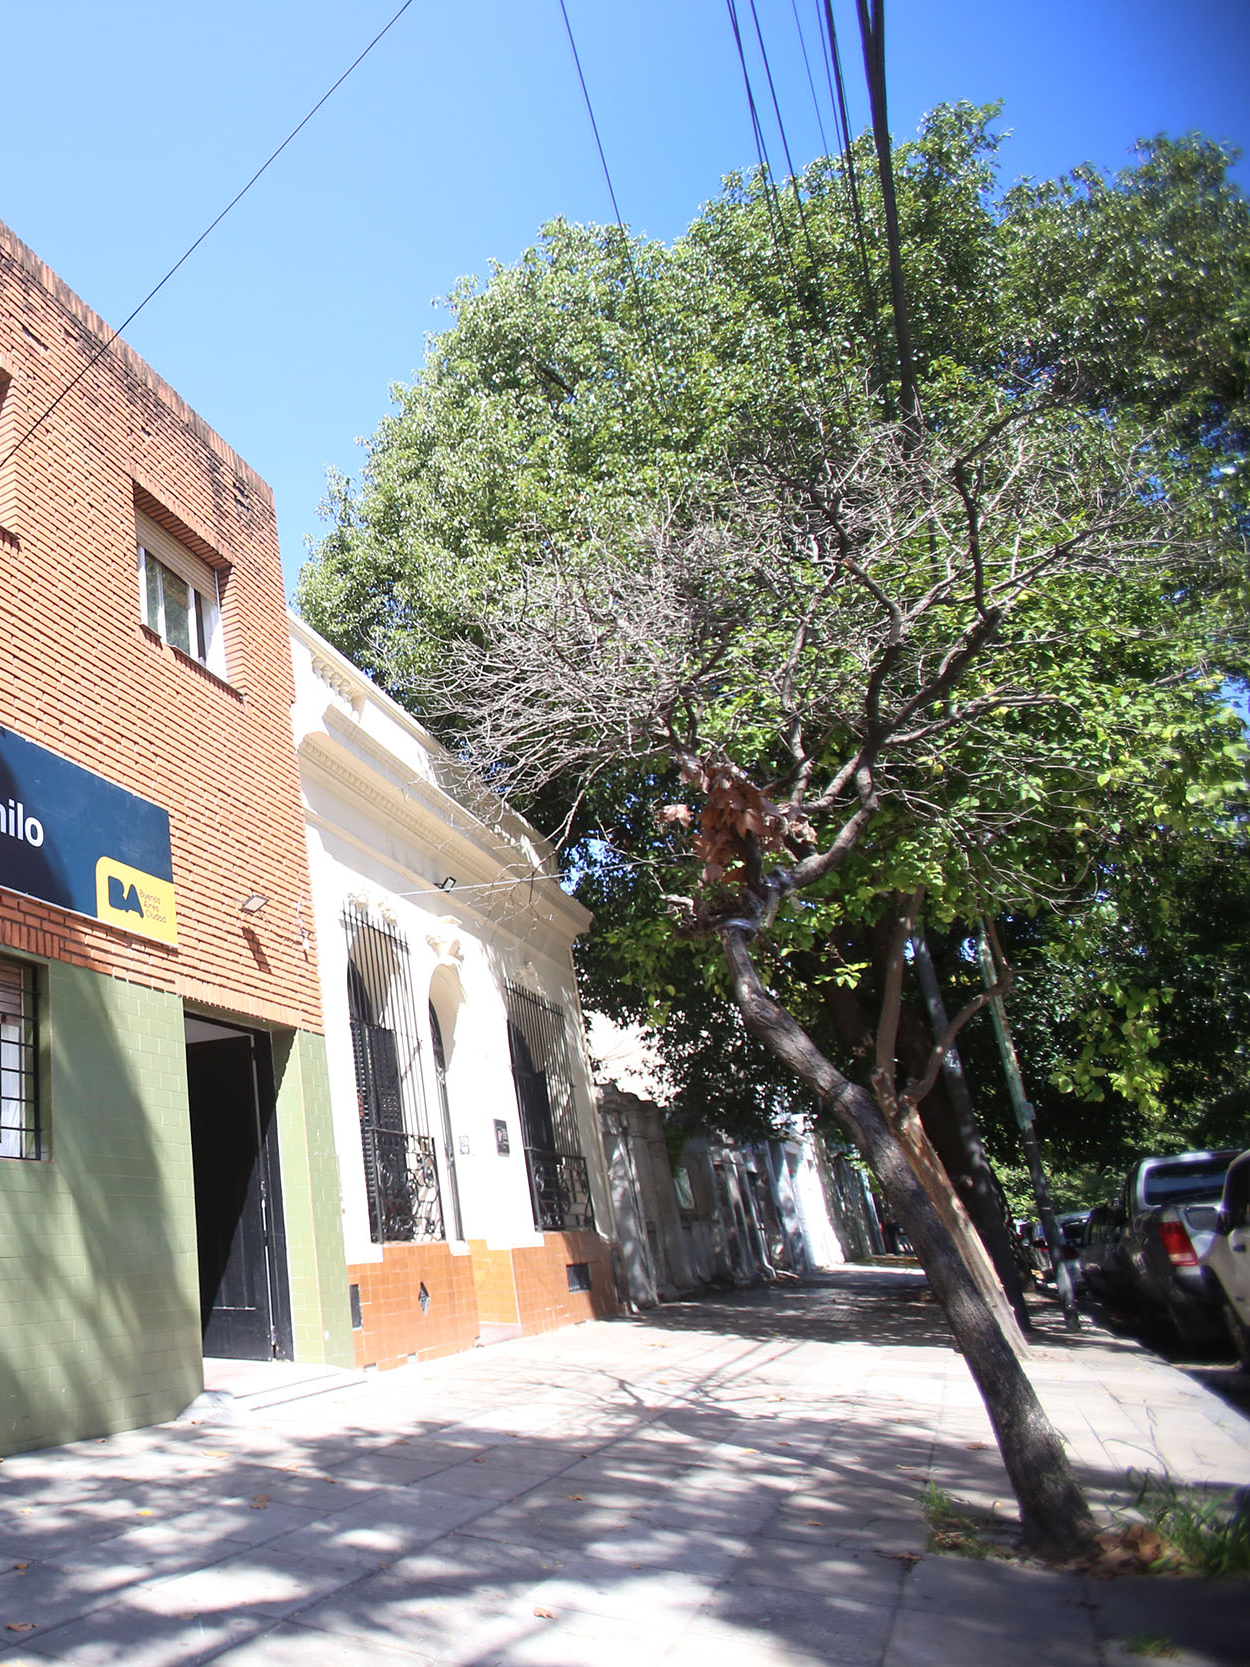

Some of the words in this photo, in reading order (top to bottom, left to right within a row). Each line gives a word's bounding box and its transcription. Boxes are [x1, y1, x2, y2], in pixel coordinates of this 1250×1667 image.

[108, 875, 144, 918] BA
[139, 889, 161, 905] Buenos
[143, 900, 160, 913] Aires
